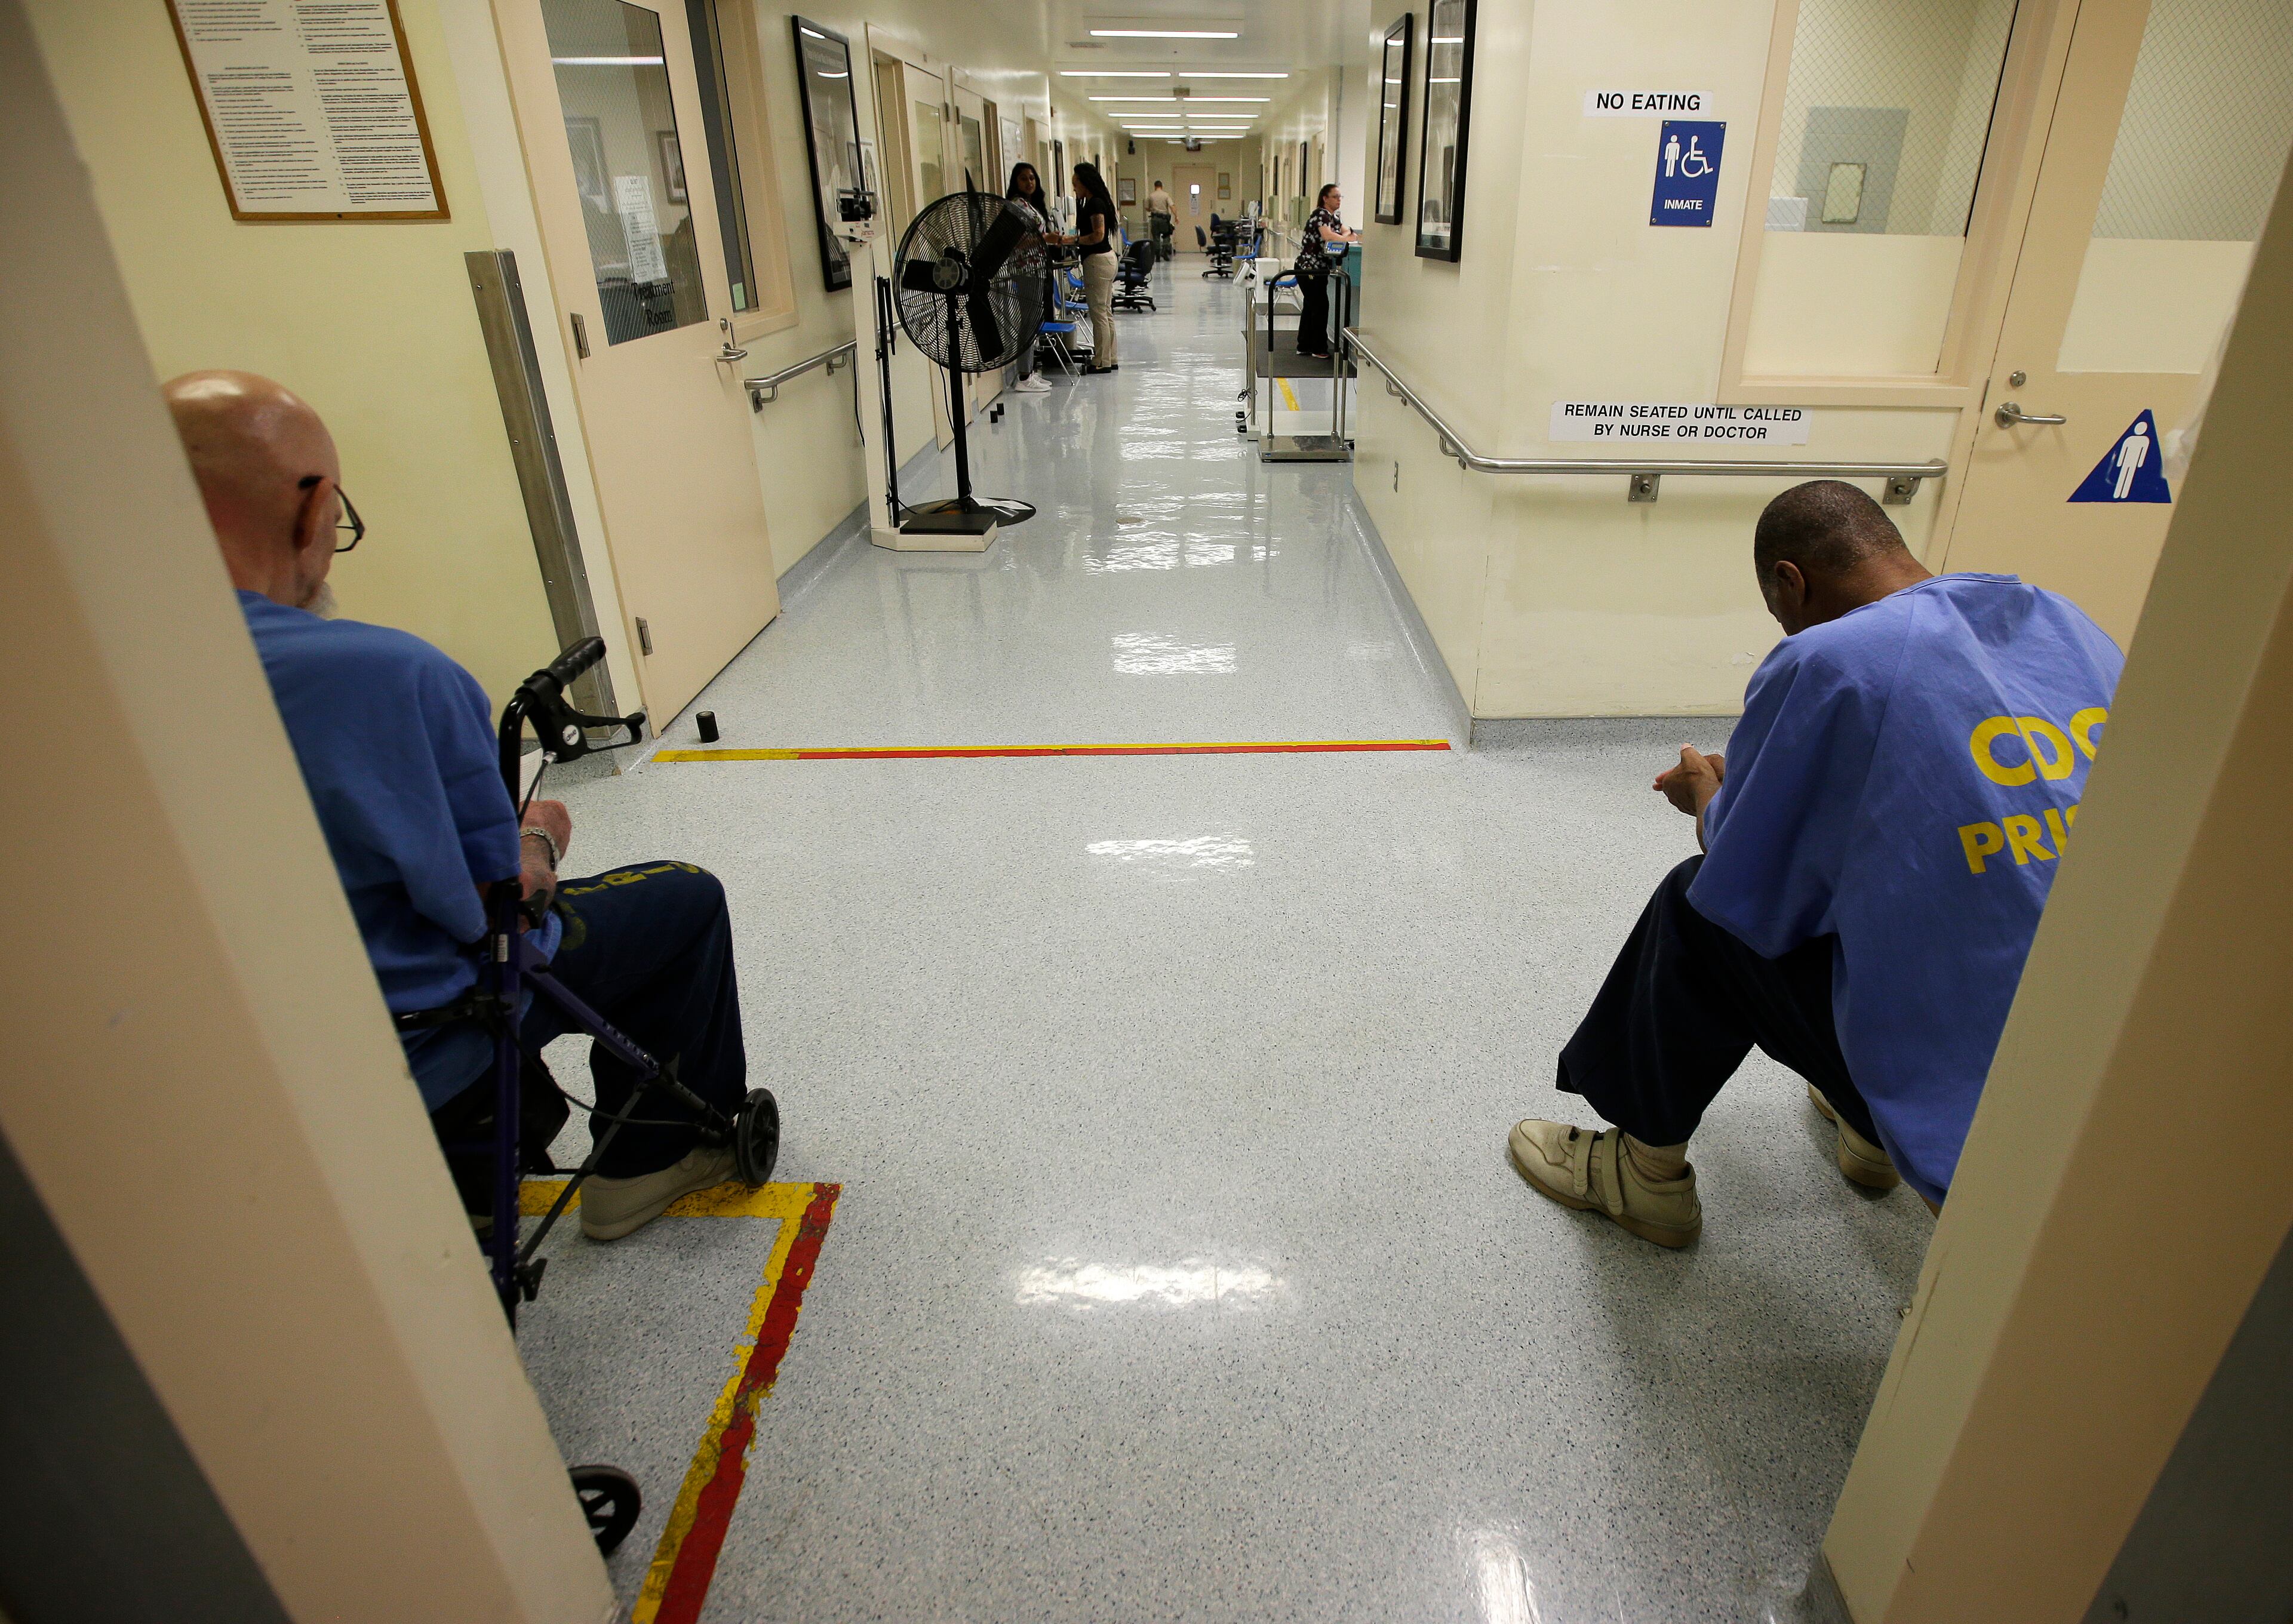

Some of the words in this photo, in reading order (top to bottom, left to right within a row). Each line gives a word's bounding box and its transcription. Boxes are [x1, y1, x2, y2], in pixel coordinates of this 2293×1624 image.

[1597, 93, 1624, 109] NO
[1631, 94, 1701, 110] EATING
[1664, 199, 1703, 210] INMATE
[631, 279, 675, 300] Treatment
[646, 309, 673, 327] Room
[1564, 404, 1624, 417] REMAIN
[1630, 405, 1688, 419] SEATED
[1694, 407, 1736, 419] UNTIL
[1744, 407, 1802, 422] CALLED
[1594, 423, 1614, 436] BY
[1619, 424, 1671, 437] NURSE
[1677, 425, 1698, 438] OR
[1704, 426, 1767, 439] DOCTOR
[1957, 805, 2079, 875] PRI
